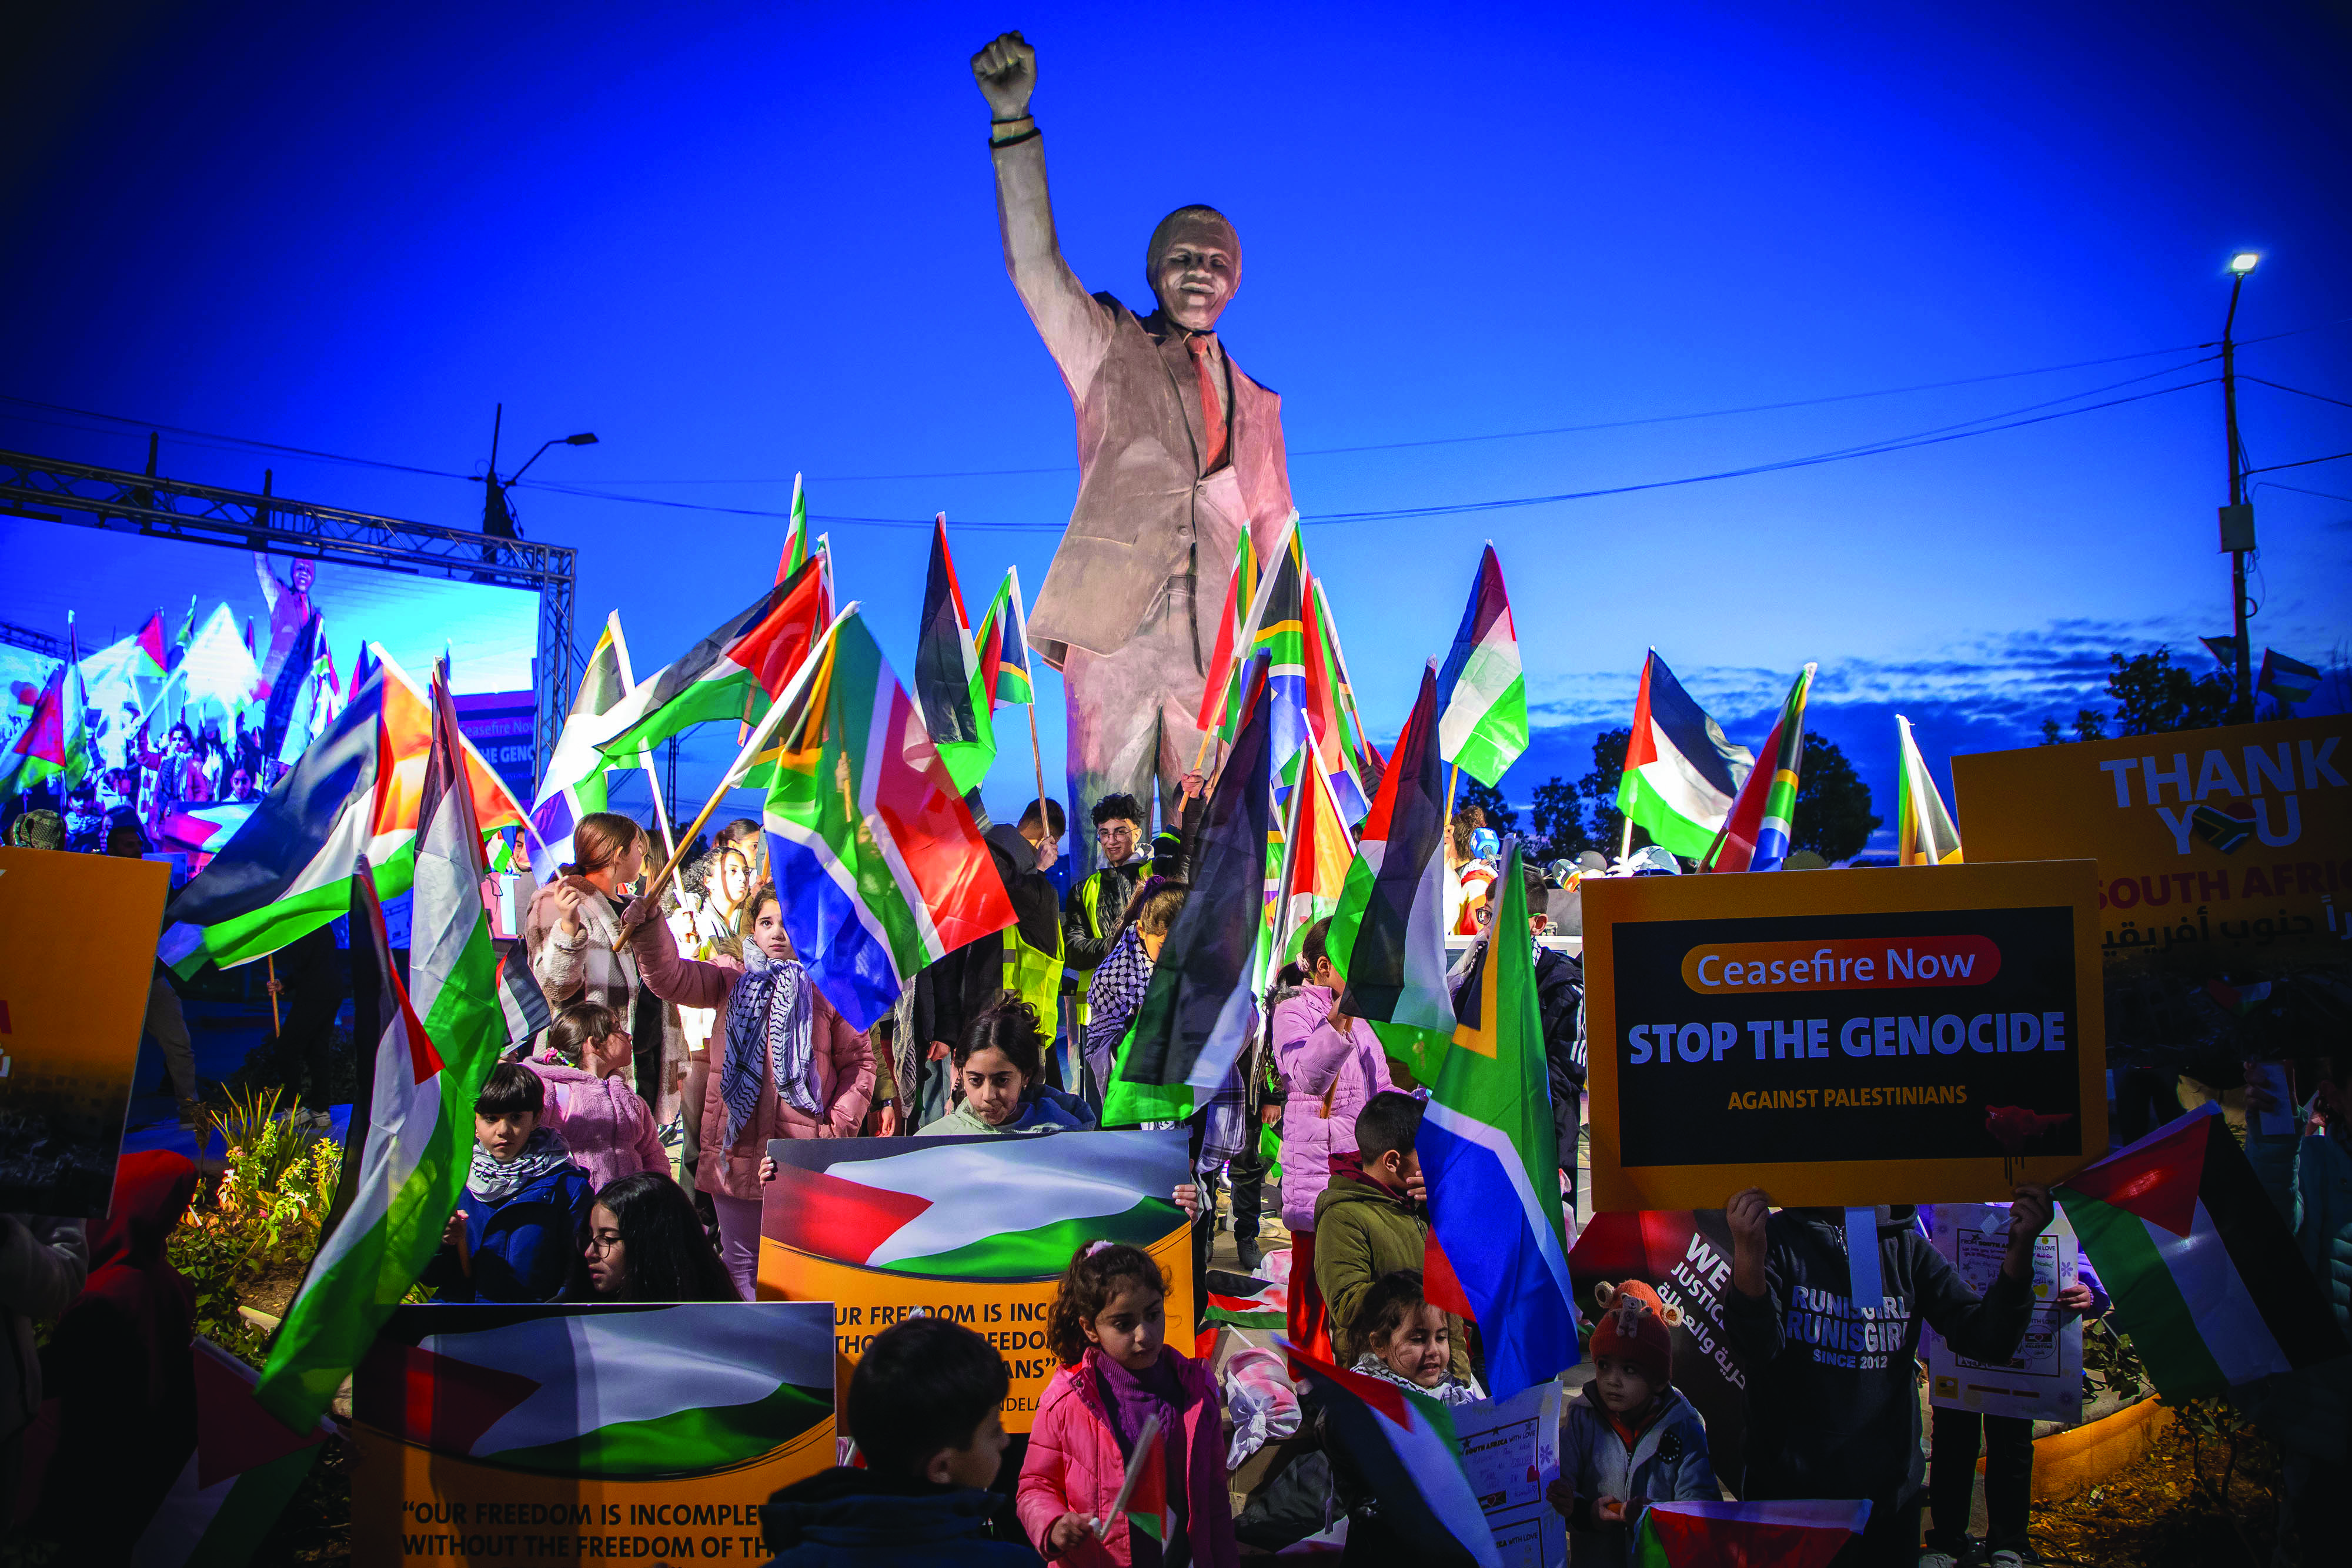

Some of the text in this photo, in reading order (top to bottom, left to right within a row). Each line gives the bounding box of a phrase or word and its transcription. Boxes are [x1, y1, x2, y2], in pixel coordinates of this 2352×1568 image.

[478, 747, 497, 764] HE
[2099, 737, 2350, 808] THANK
[2102, 905, 2210, 957] أفريقي
[2220, 909, 2314, 947] جنوب
[1697, 948, 1976, 986] Ceasefire Now
[1628, 1011, 2066, 1064] STOP THE GENOCIDE
[1728, 1085, 1967, 1110] AGAINST PALESTINIANS
[1686, 1232, 1732, 1292] WE
[835, 1307, 862, 1325] UR
[984, 1303, 1002, 1322] IS
[1813, 1349, 1888, 1369] SINCE 2012
[1465, 1445, 1485, 1456] SOUTH
[1486, 1438, 1508, 1449] AFRICA
[1509, 1434, 1522, 1443] WITH
[1522, 1430, 1535, 1439] LOVE
[476, 1503, 592, 1525] FREEDOM
[602, 1503, 620, 1525] IS
[631, 1503, 766, 1526] INCOMPLE
[402, 1534, 517, 1557] WITHOUT
[524, 1535, 569, 1557] THE
[577, 1536, 694, 1558] FREEDOM
[701, 1536, 733, 1558] OF
[1508, 1536, 1522, 1544] WITH
[1523, 1532, 1538, 1542] LOVE
